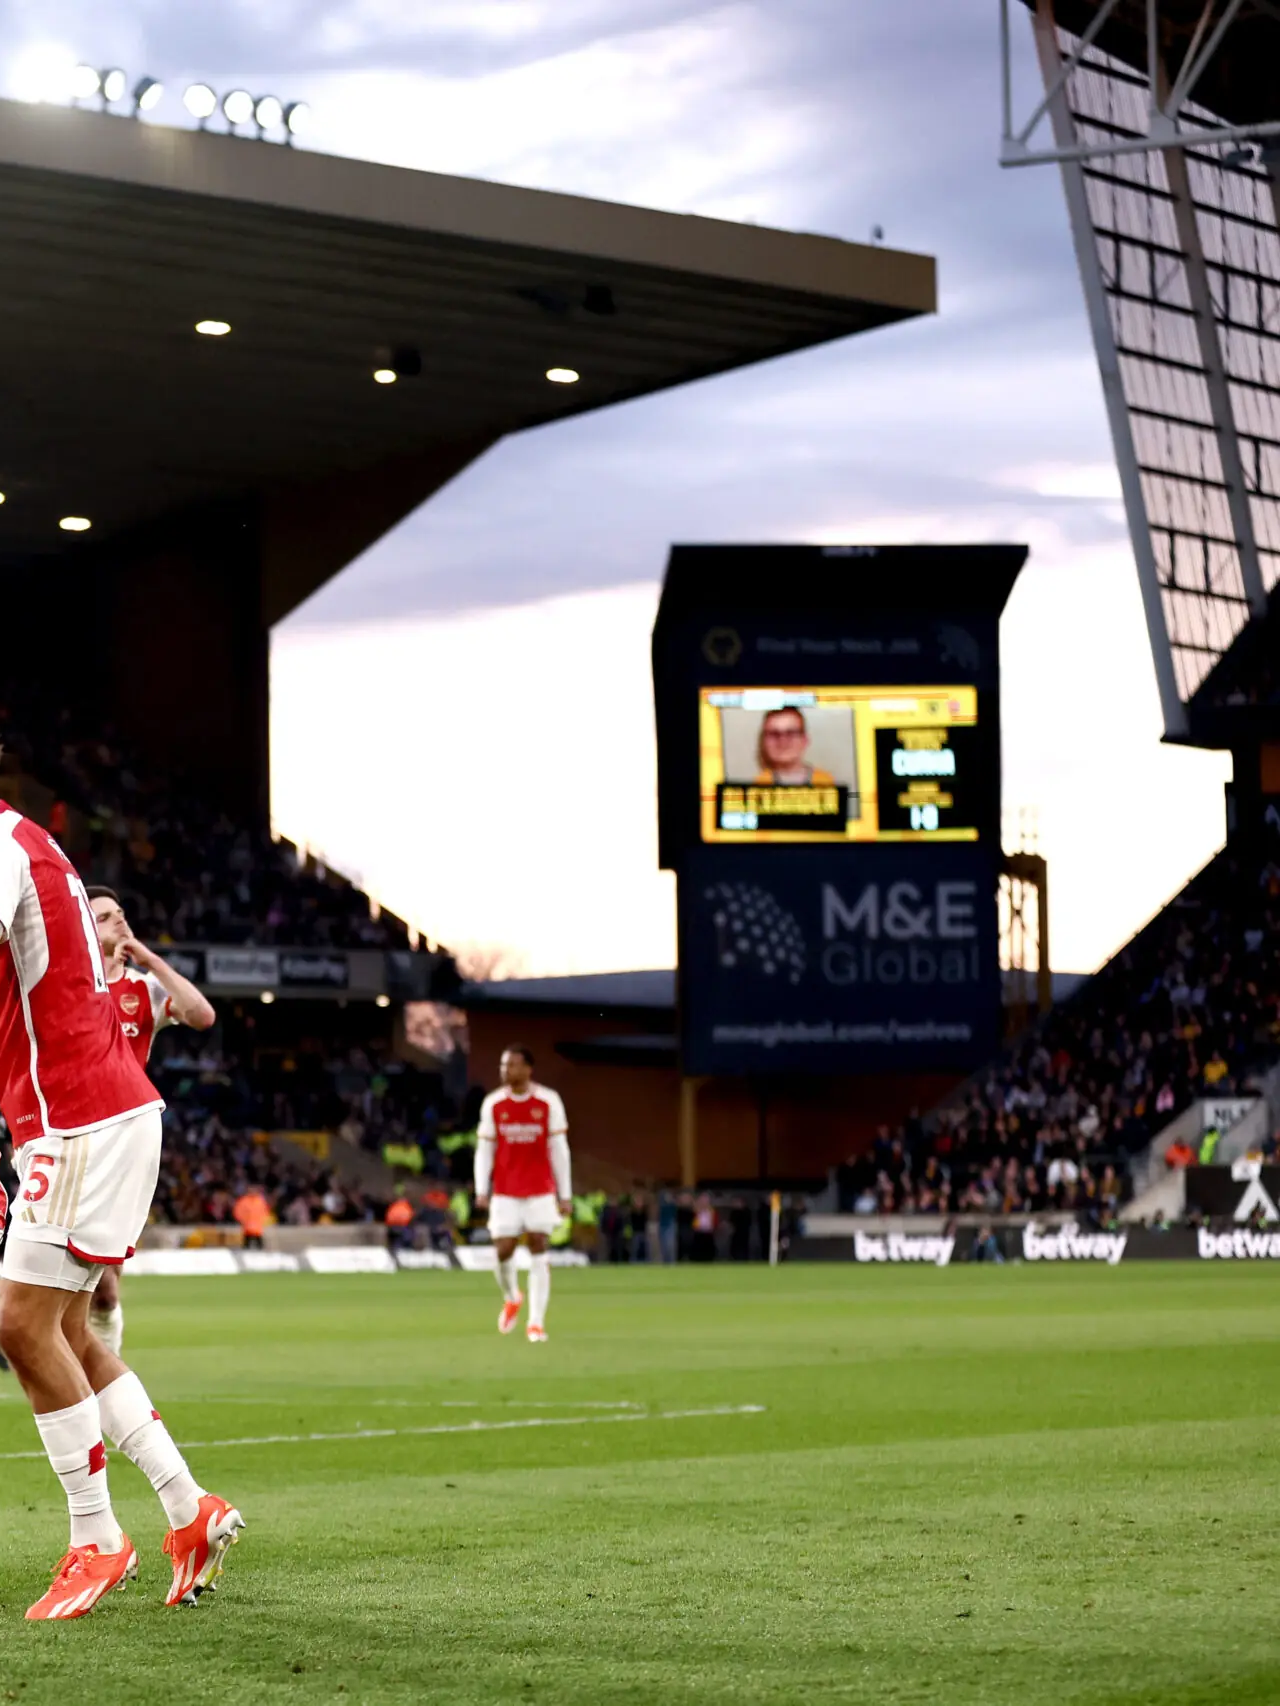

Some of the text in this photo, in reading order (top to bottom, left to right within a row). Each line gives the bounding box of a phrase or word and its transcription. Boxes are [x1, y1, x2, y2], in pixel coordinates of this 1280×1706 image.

[65, 872, 111, 993] 1
[822, 881, 978, 940] M&E
[822, 940, 980, 985] Global
[1022, 1224, 1128, 1266] betway
[1197, 1226, 1280, 1260] betwa
